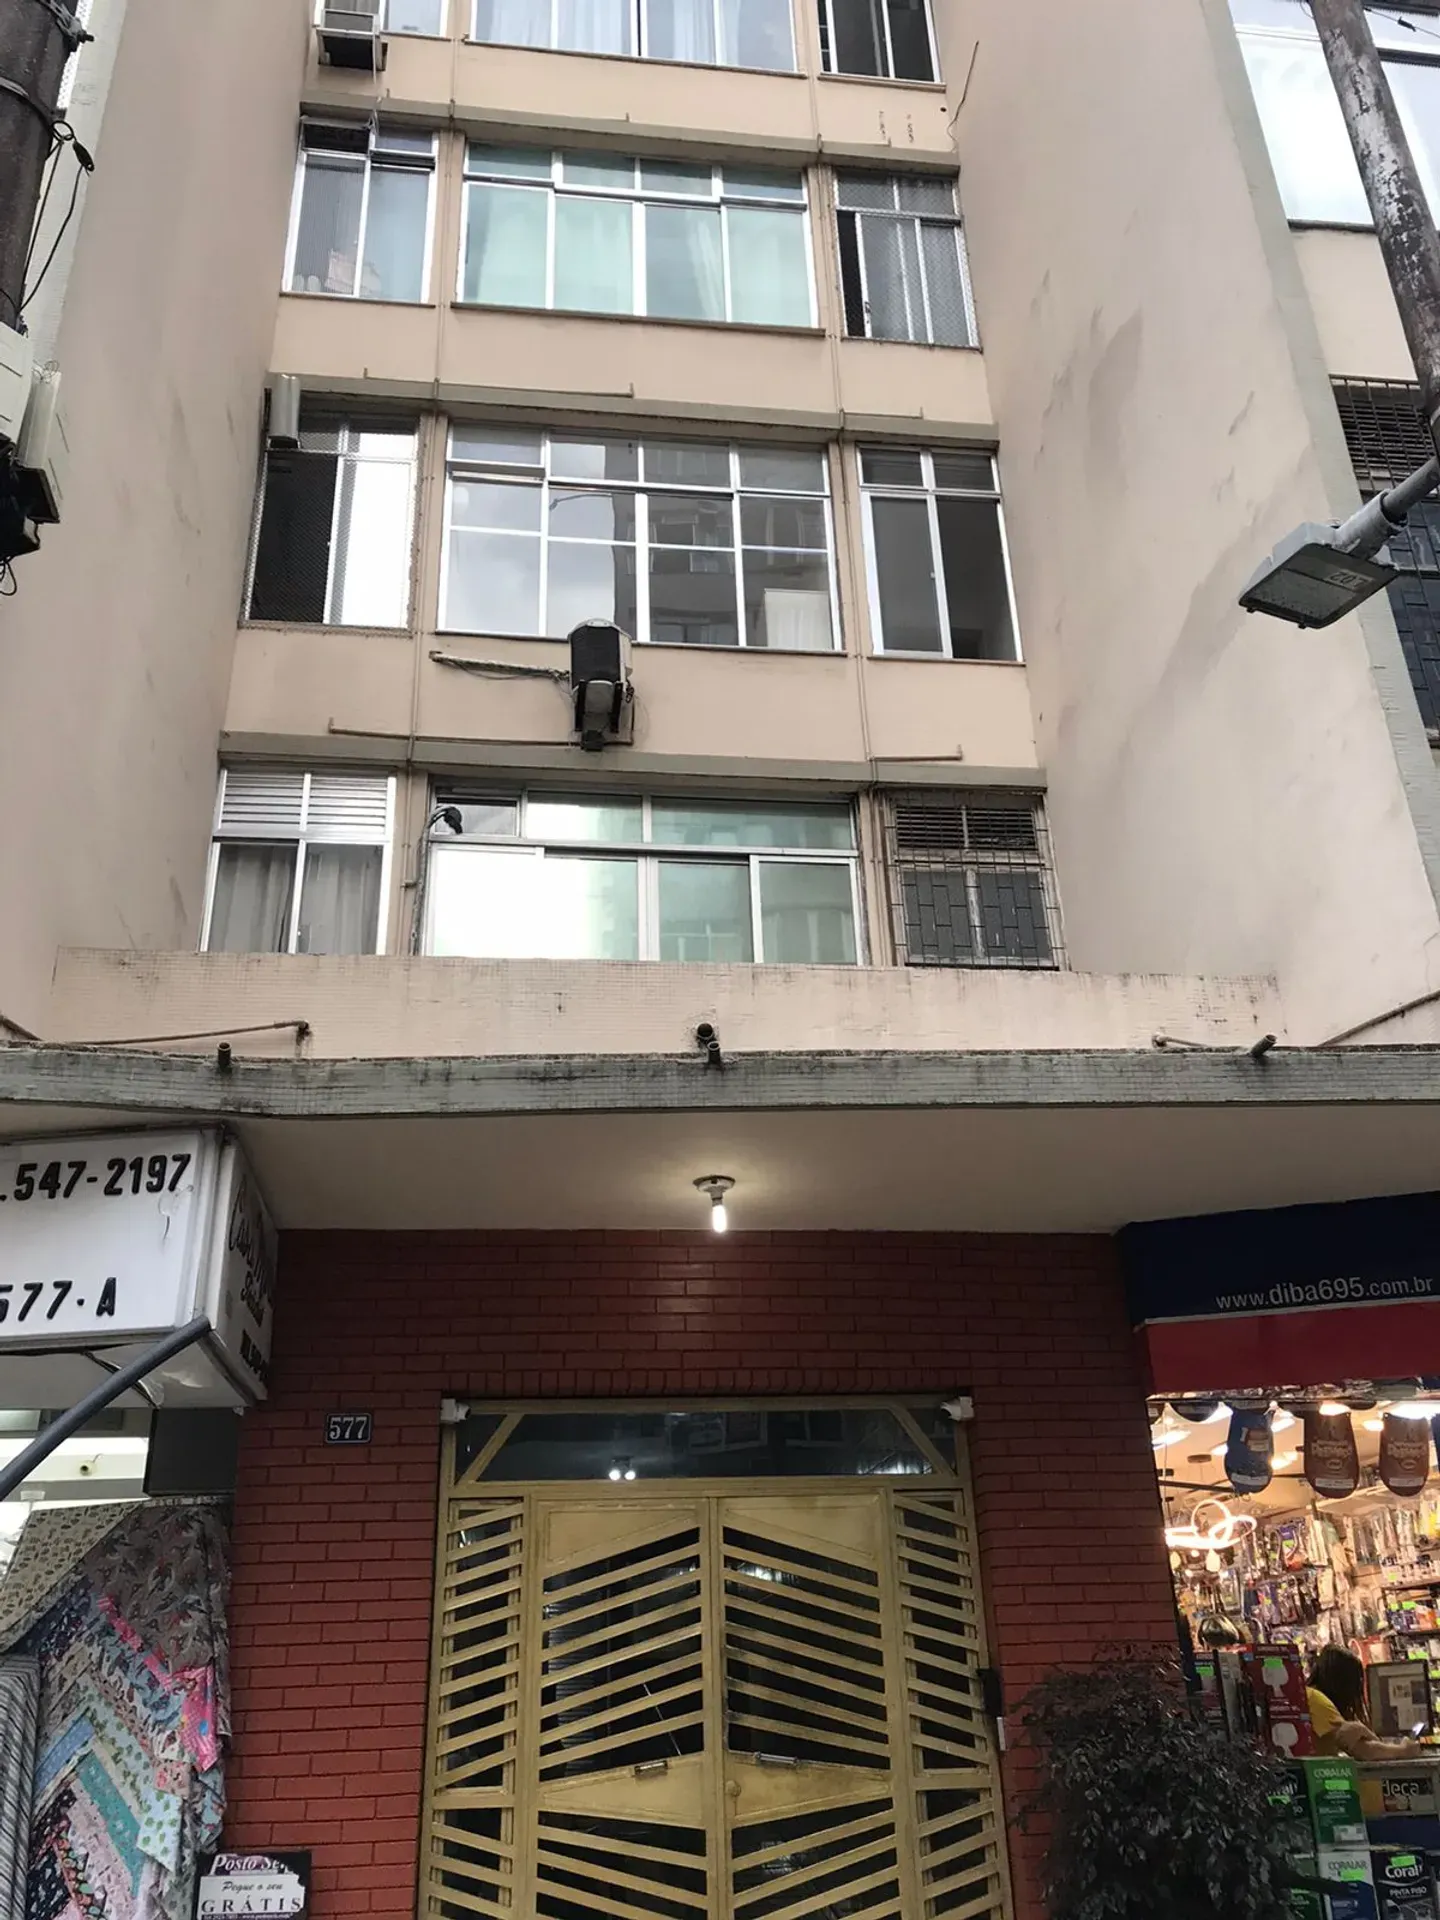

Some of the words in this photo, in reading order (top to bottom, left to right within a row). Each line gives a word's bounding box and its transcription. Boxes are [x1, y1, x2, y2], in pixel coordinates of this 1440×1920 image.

[1215, 1276, 1434, 1310] www.diba695.com.br
[329, 1416, 368, 1440] 577
[208, 1853, 258, 1876] Posto
[1384, 1863, 1420, 1879] Coral
[221, 1880, 255, 1894] Pegue
[256, 1883, 264, 1891] o
[266, 1883, 283, 1891] seu
[201, 1895, 301, 1913] GRÁTIS
